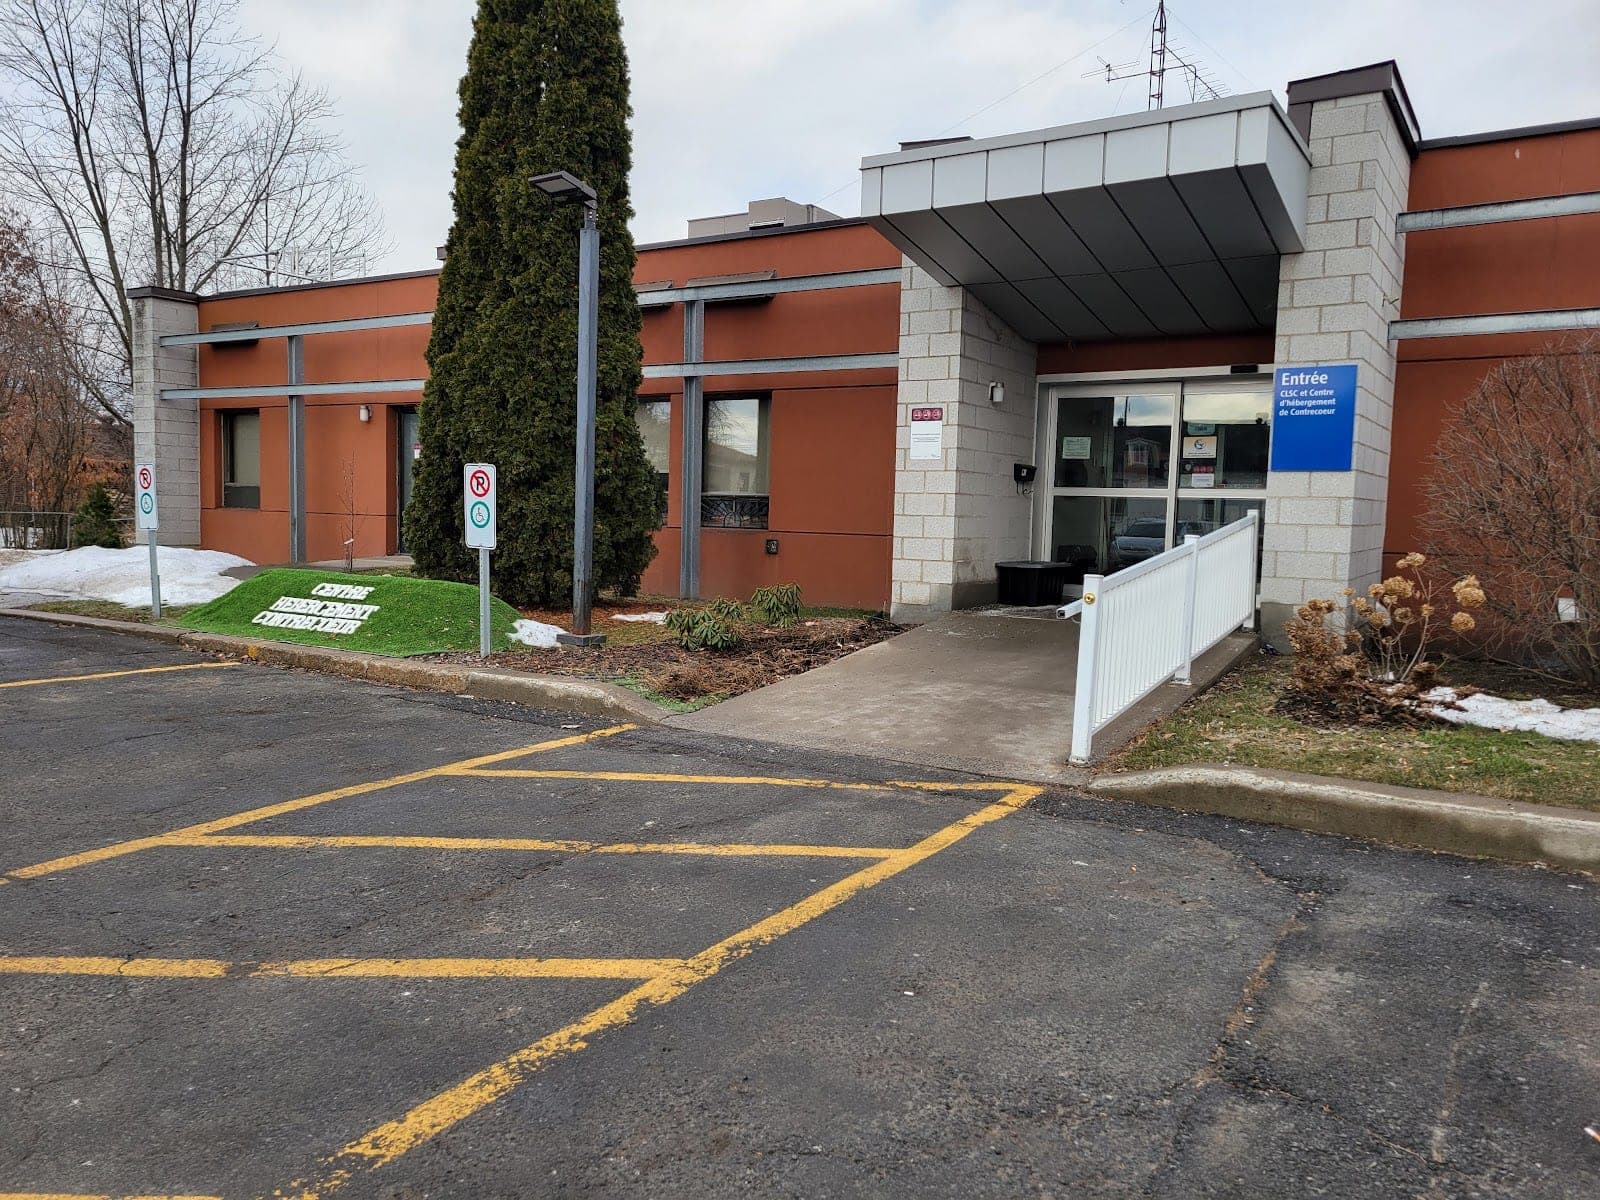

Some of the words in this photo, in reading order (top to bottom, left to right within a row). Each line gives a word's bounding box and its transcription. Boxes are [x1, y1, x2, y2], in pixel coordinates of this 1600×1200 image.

[1281, 371, 1328, 386] Entrée
[1280, 389, 1299, 398] CLSC
[1309, 389, 1334, 397] Centre
[1279, 398, 1336, 407] d'hébergement
[1290, 408, 1336, 416] Contrecoeur
[311, 583, 375, 600] CENTRE
